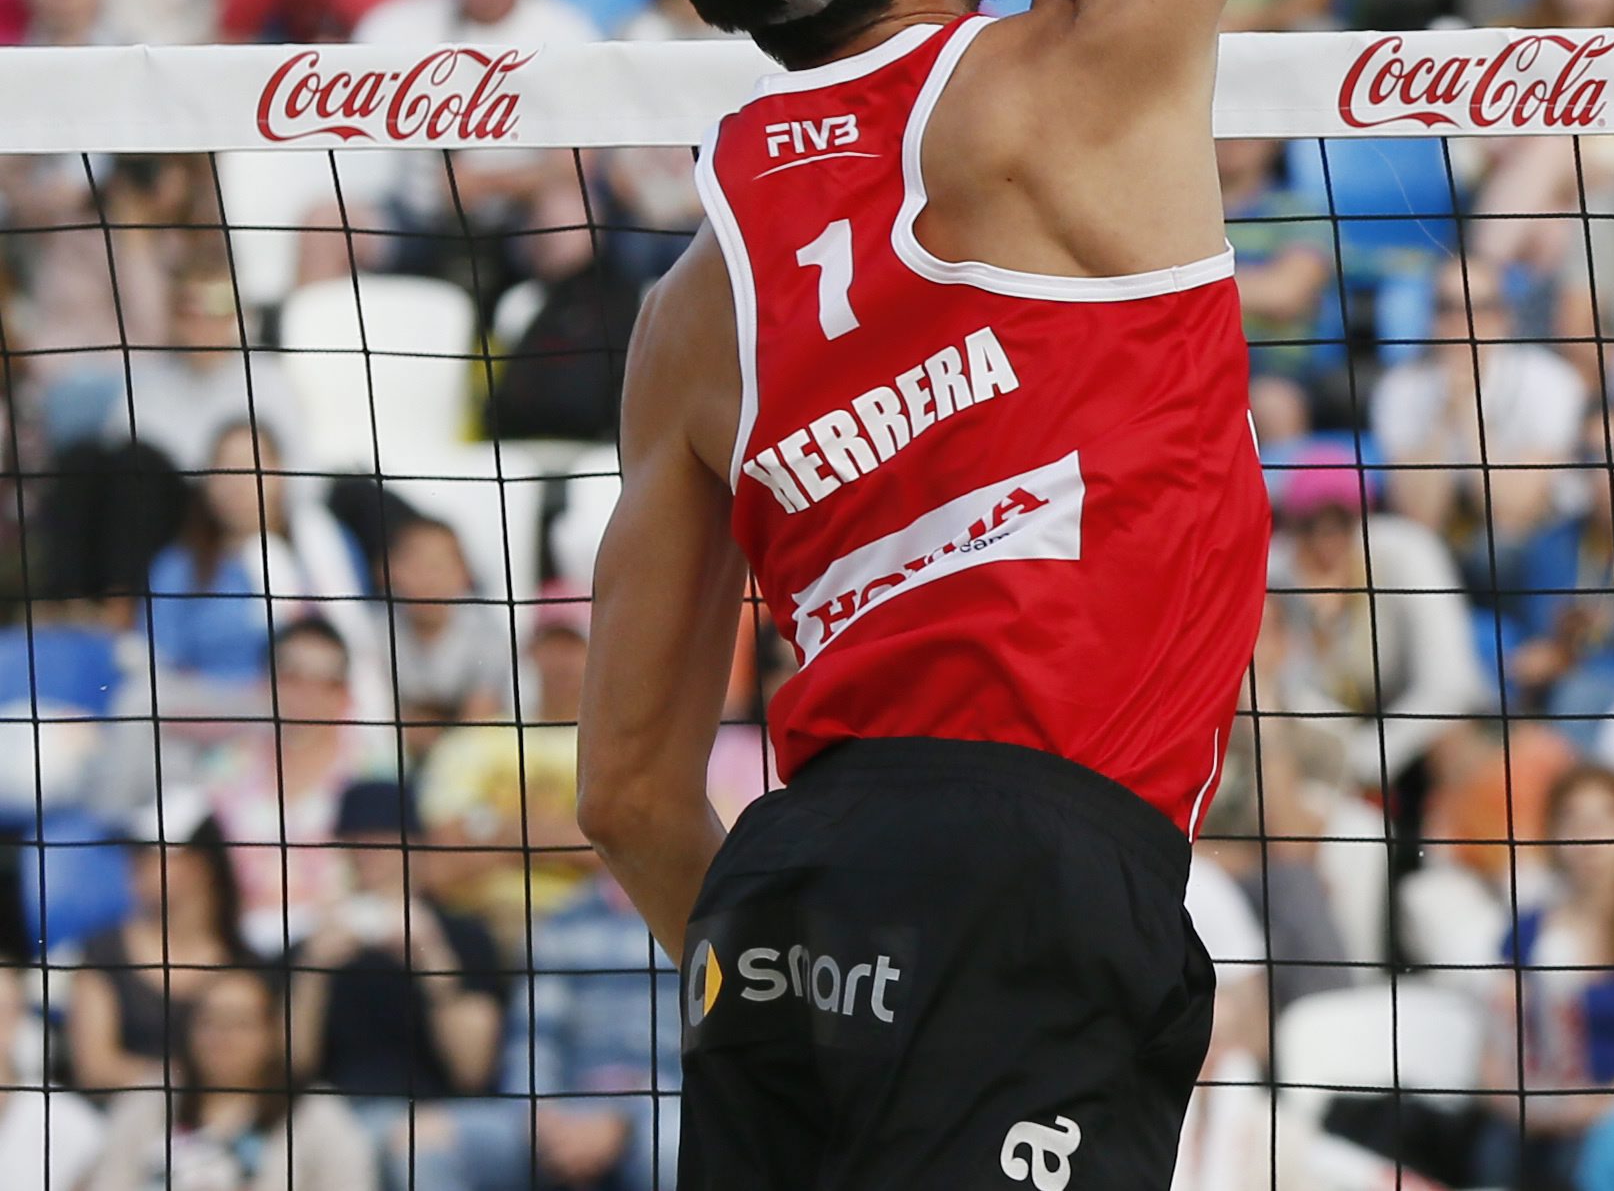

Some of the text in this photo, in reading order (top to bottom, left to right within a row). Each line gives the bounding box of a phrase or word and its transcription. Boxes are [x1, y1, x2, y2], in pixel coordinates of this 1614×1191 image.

[256, 49, 539, 143] Coca-Cola
[765, 113, 860, 158] FIVB
[795, 218, 861, 342] 1
[742, 325, 1020, 515] HERRERA
